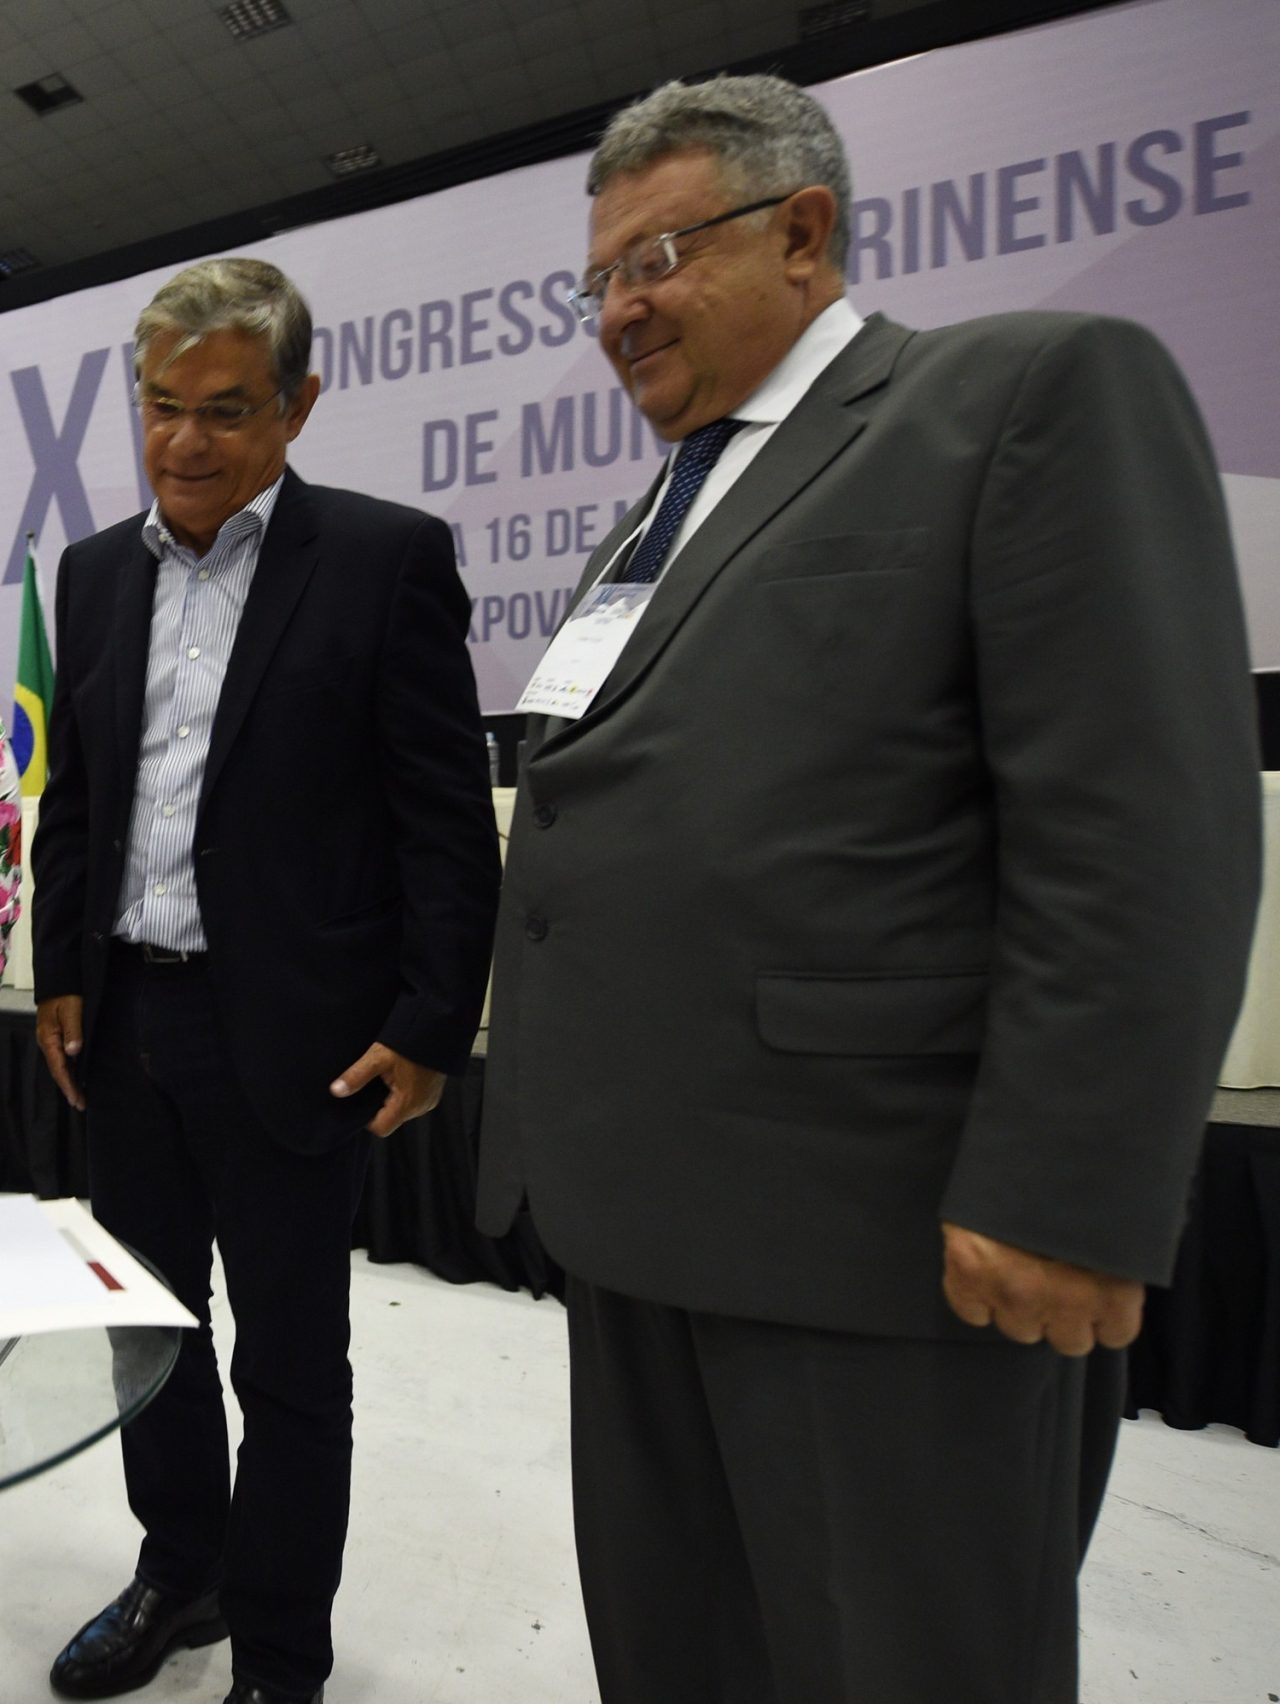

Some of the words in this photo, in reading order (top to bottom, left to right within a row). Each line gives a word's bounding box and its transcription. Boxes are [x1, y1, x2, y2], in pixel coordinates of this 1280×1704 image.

[312, 270, 599, 396] ONGRESS
[422, 409, 498, 493] DE
[485, 516, 531, 563] 16
[546, 504, 598, 557] DE
